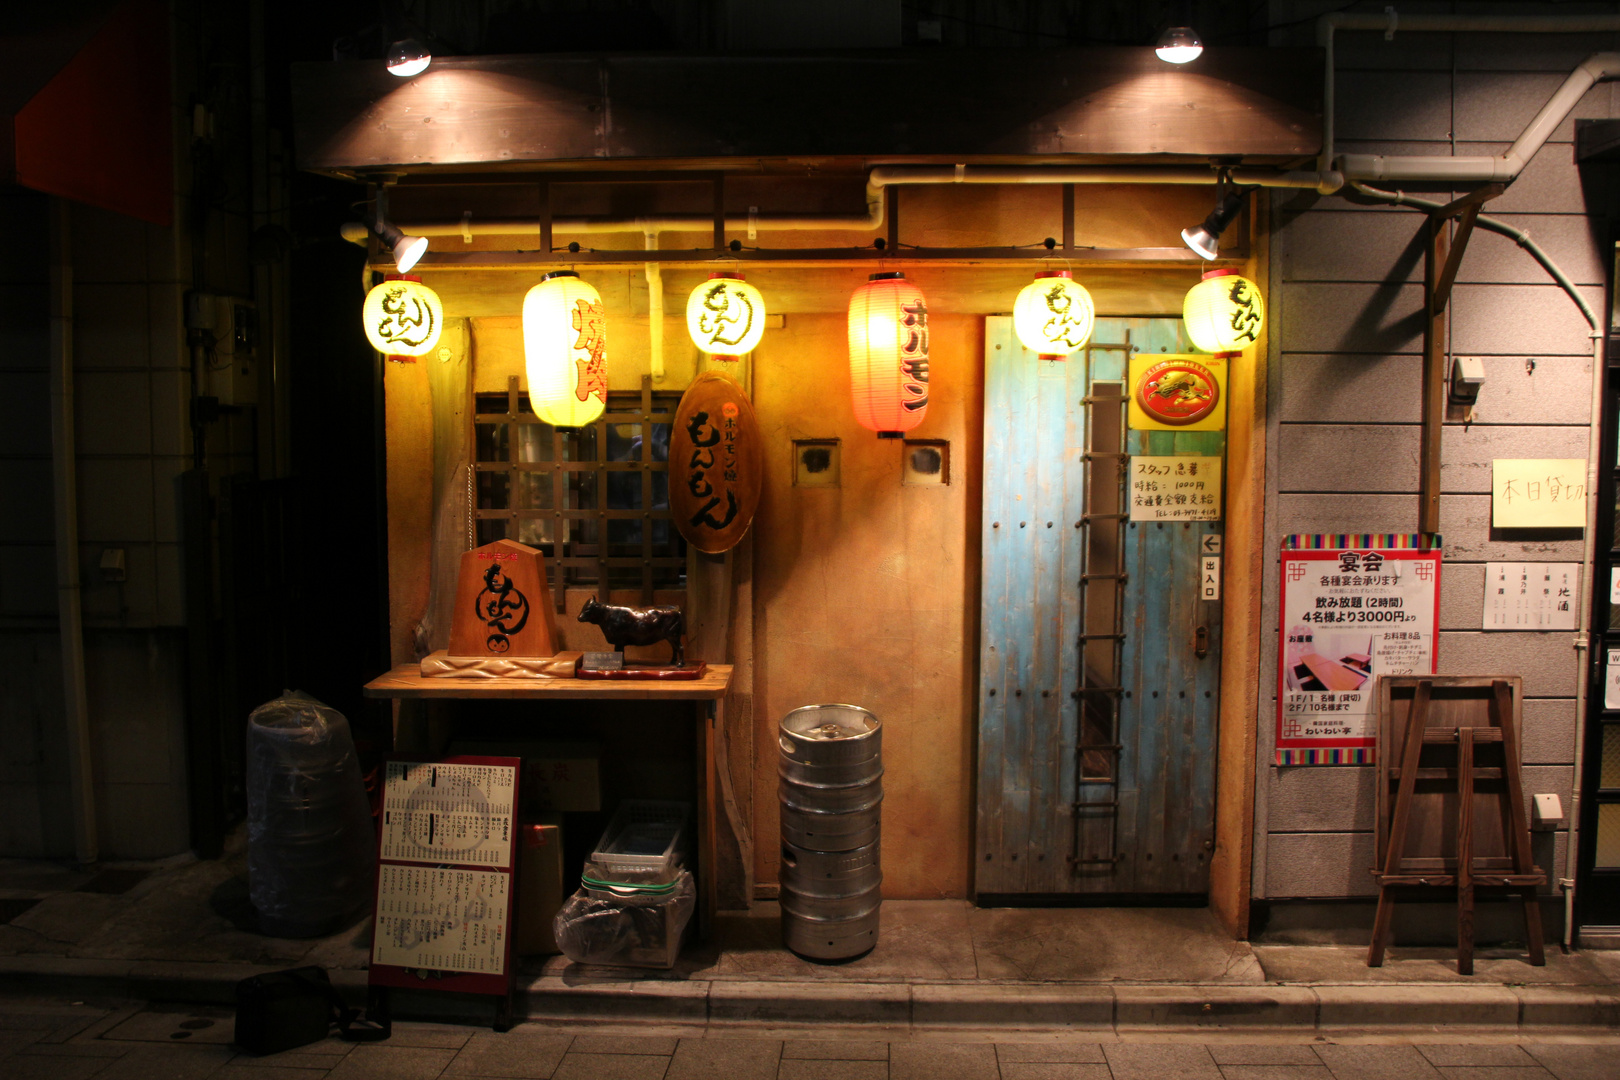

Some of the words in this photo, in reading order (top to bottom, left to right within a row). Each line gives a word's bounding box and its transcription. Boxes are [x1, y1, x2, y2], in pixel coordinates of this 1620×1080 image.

[686, 411, 738, 530] もんもん
[1138, 464, 1170, 475] スタッフ
[1135, 481, 1158, 491] 時給
[1176, 482, 1205, 491] 1000円
[1502, 475, 1584, 505] 本日貸切
[1338, 552, 1384, 573] 宴会
[1205, 560, 1215, 597] 出入口
[1320, 575, 1399, 587] 各種宴会承ります
[475, 563, 530, 636] もんもん
[1315, 597, 1362, 608] 飲み放題
[1557, 587, 1571, 612] 地酒
[1305, 726, 1352, 735] わいわい亭
